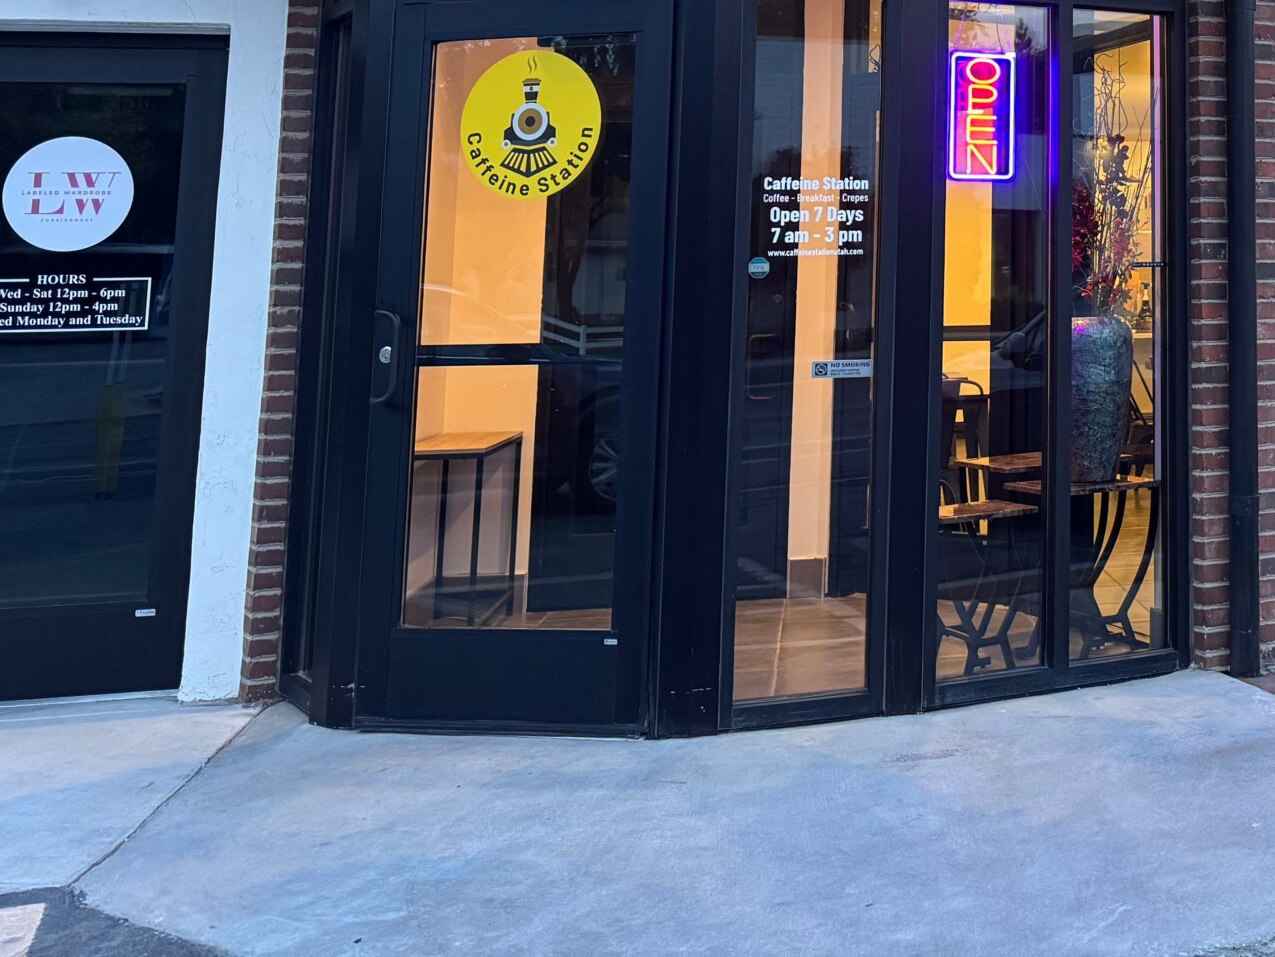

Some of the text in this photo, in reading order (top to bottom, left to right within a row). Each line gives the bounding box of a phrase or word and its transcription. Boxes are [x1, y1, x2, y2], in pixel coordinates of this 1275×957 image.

[966, 58, 1001, 175] OPEN
[467, 127, 594, 197] Caffeine Station
[763, 176, 869, 191] Caffeine Station
[763, 193, 790, 203] Coffee
[796, 193, 835, 203] Breakfast
[842, 192, 869, 204] Crepes
[769, 206, 864, 226] Open 7 Days
[771, 227, 781, 243] 7
[784, 230, 809, 243] am
[824, 227, 835, 243] 3
[838, 229, 863, 246] pm
[37, 274, 87, 285] HOURS
[32, 288, 53, 299] Sat
[56, 288, 89, 300] 12pm
[99, 287, 126, 300] 6pm
[0, 302, 45, 315] Sunday
[48, 302, 81, 314] 12pm
[91, 301, 119, 314] 4pm
[16, 315, 66, 328] Monday
[68, 315, 92, 325] and
[94, 314, 143, 326] Tuesday
